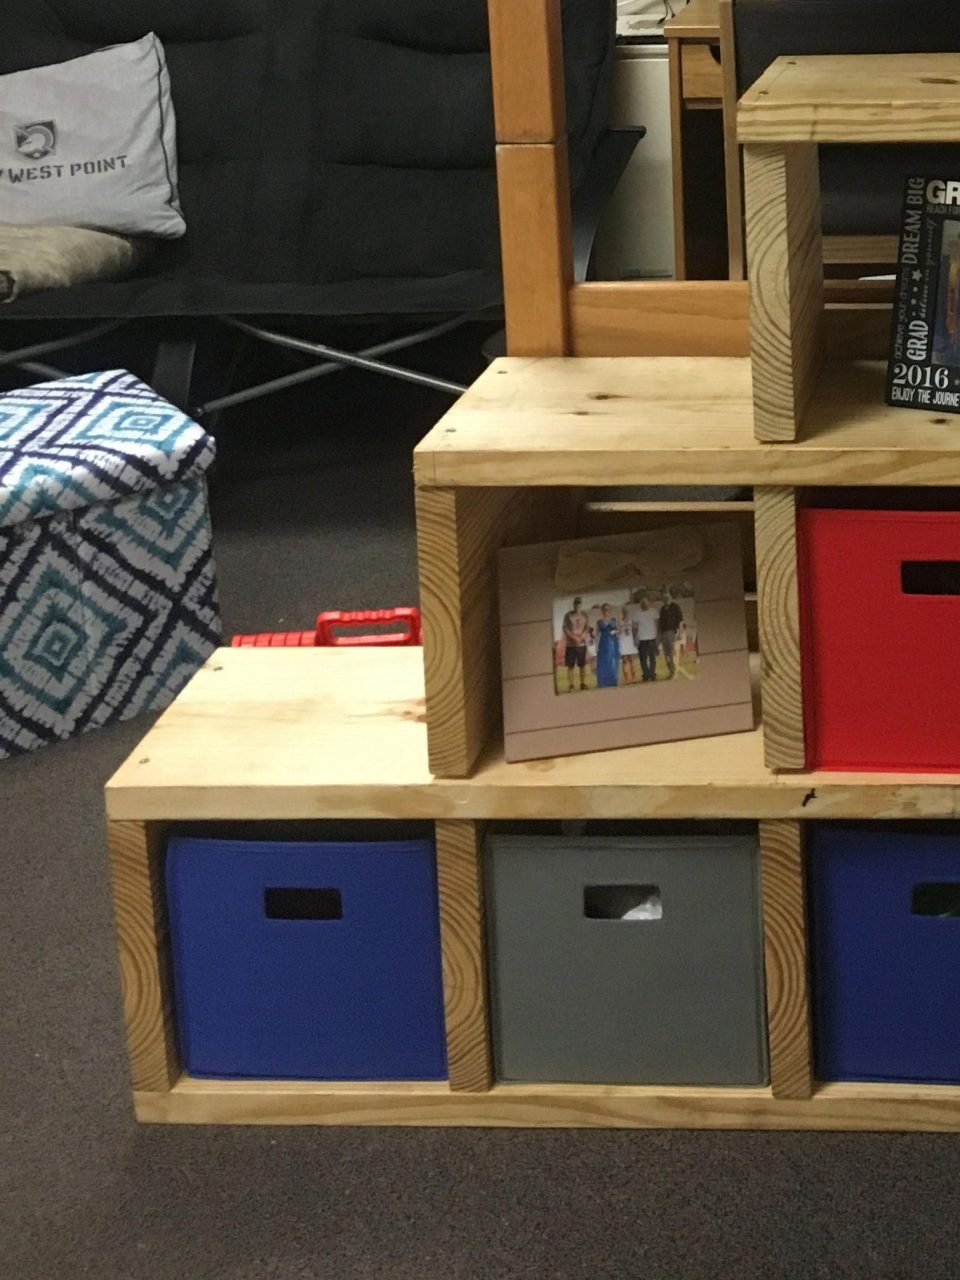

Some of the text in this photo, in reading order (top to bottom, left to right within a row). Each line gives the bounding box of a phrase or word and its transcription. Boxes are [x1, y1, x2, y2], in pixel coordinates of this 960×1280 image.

[8, 165, 65, 183] WEST
[70, 155, 128, 177] POINT
[901, 177, 925, 265] DREAM BIG
[907, 320, 929, 361] GRAD
[893, 363, 949, 389] 2016
[891, 387, 915, 402] ENJOY
[917, 389, 931, 403] THE
